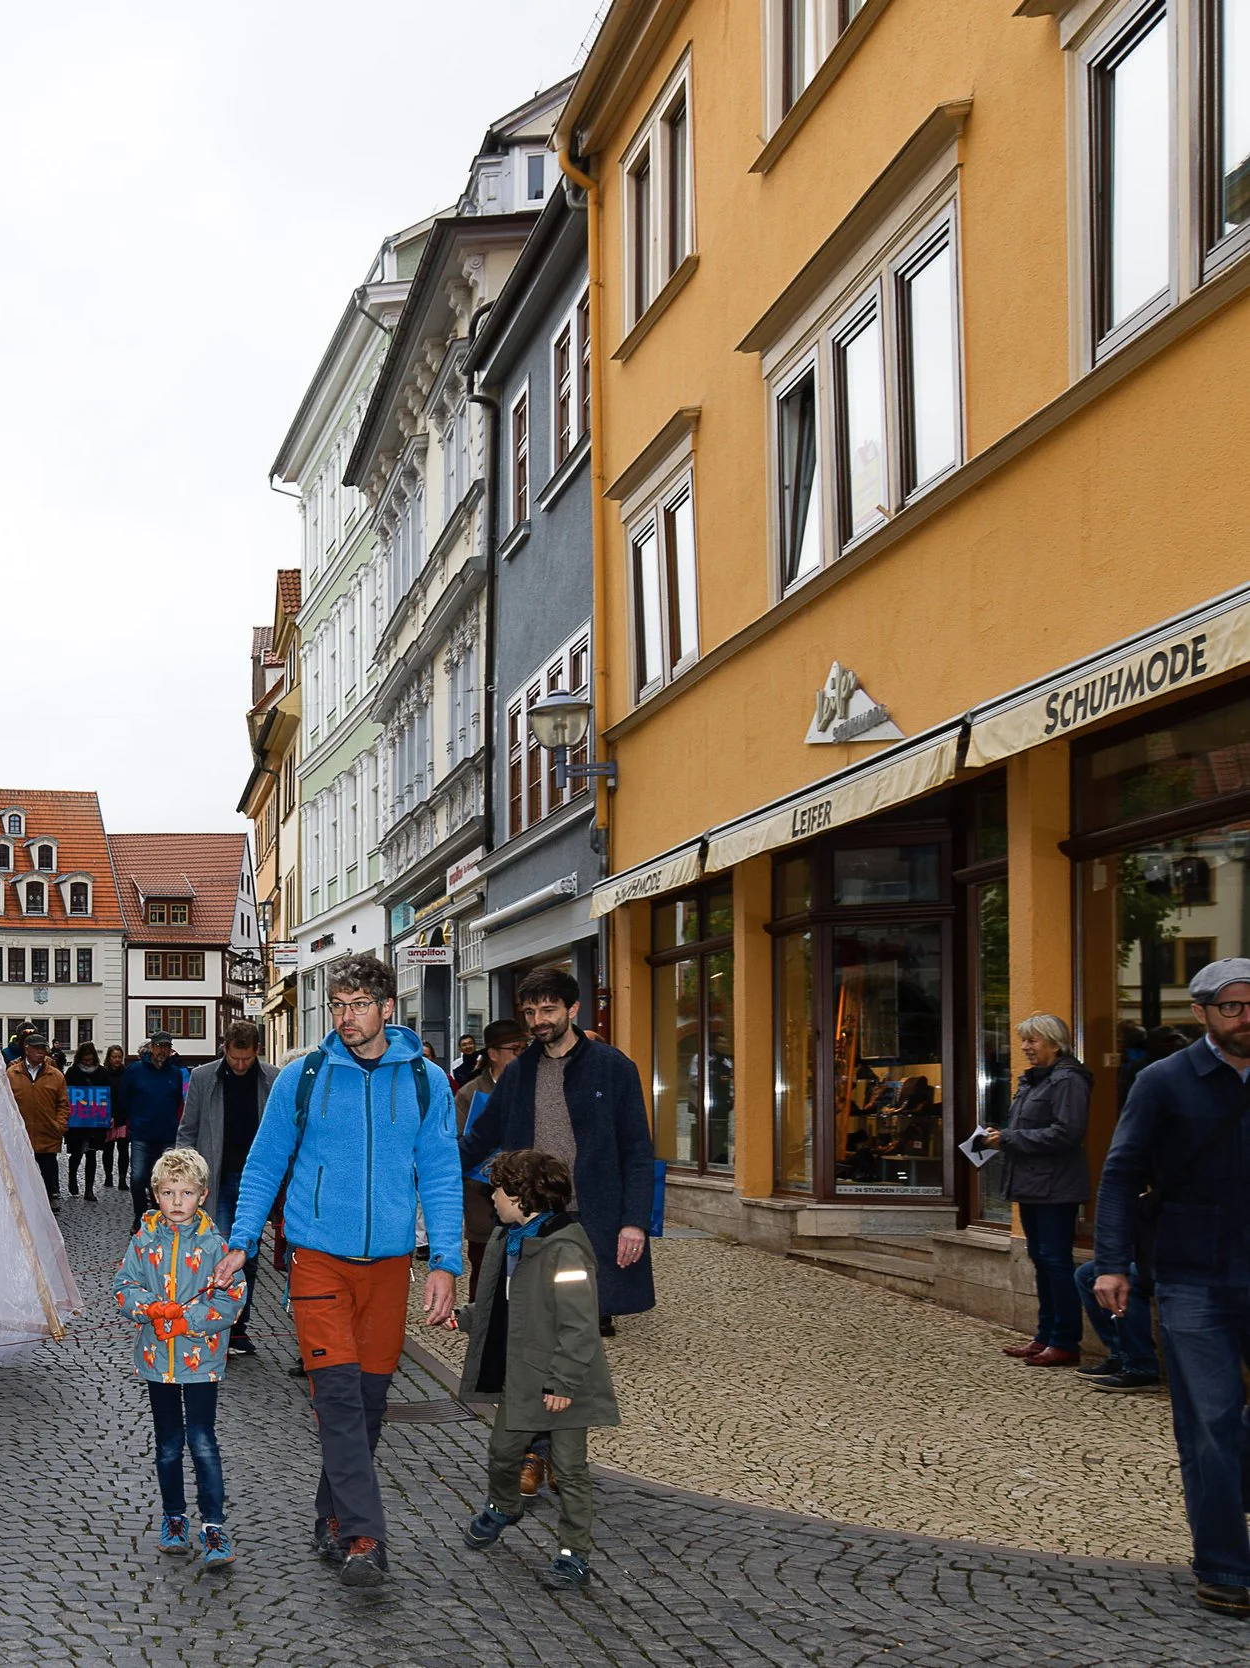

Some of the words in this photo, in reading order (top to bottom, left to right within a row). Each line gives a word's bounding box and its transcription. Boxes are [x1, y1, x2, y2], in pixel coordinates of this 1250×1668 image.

[1044, 633, 1207, 735] SCHUHMODE
[407, 949, 446, 958] amplifon
[66, 1088, 107, 1106] RIE
